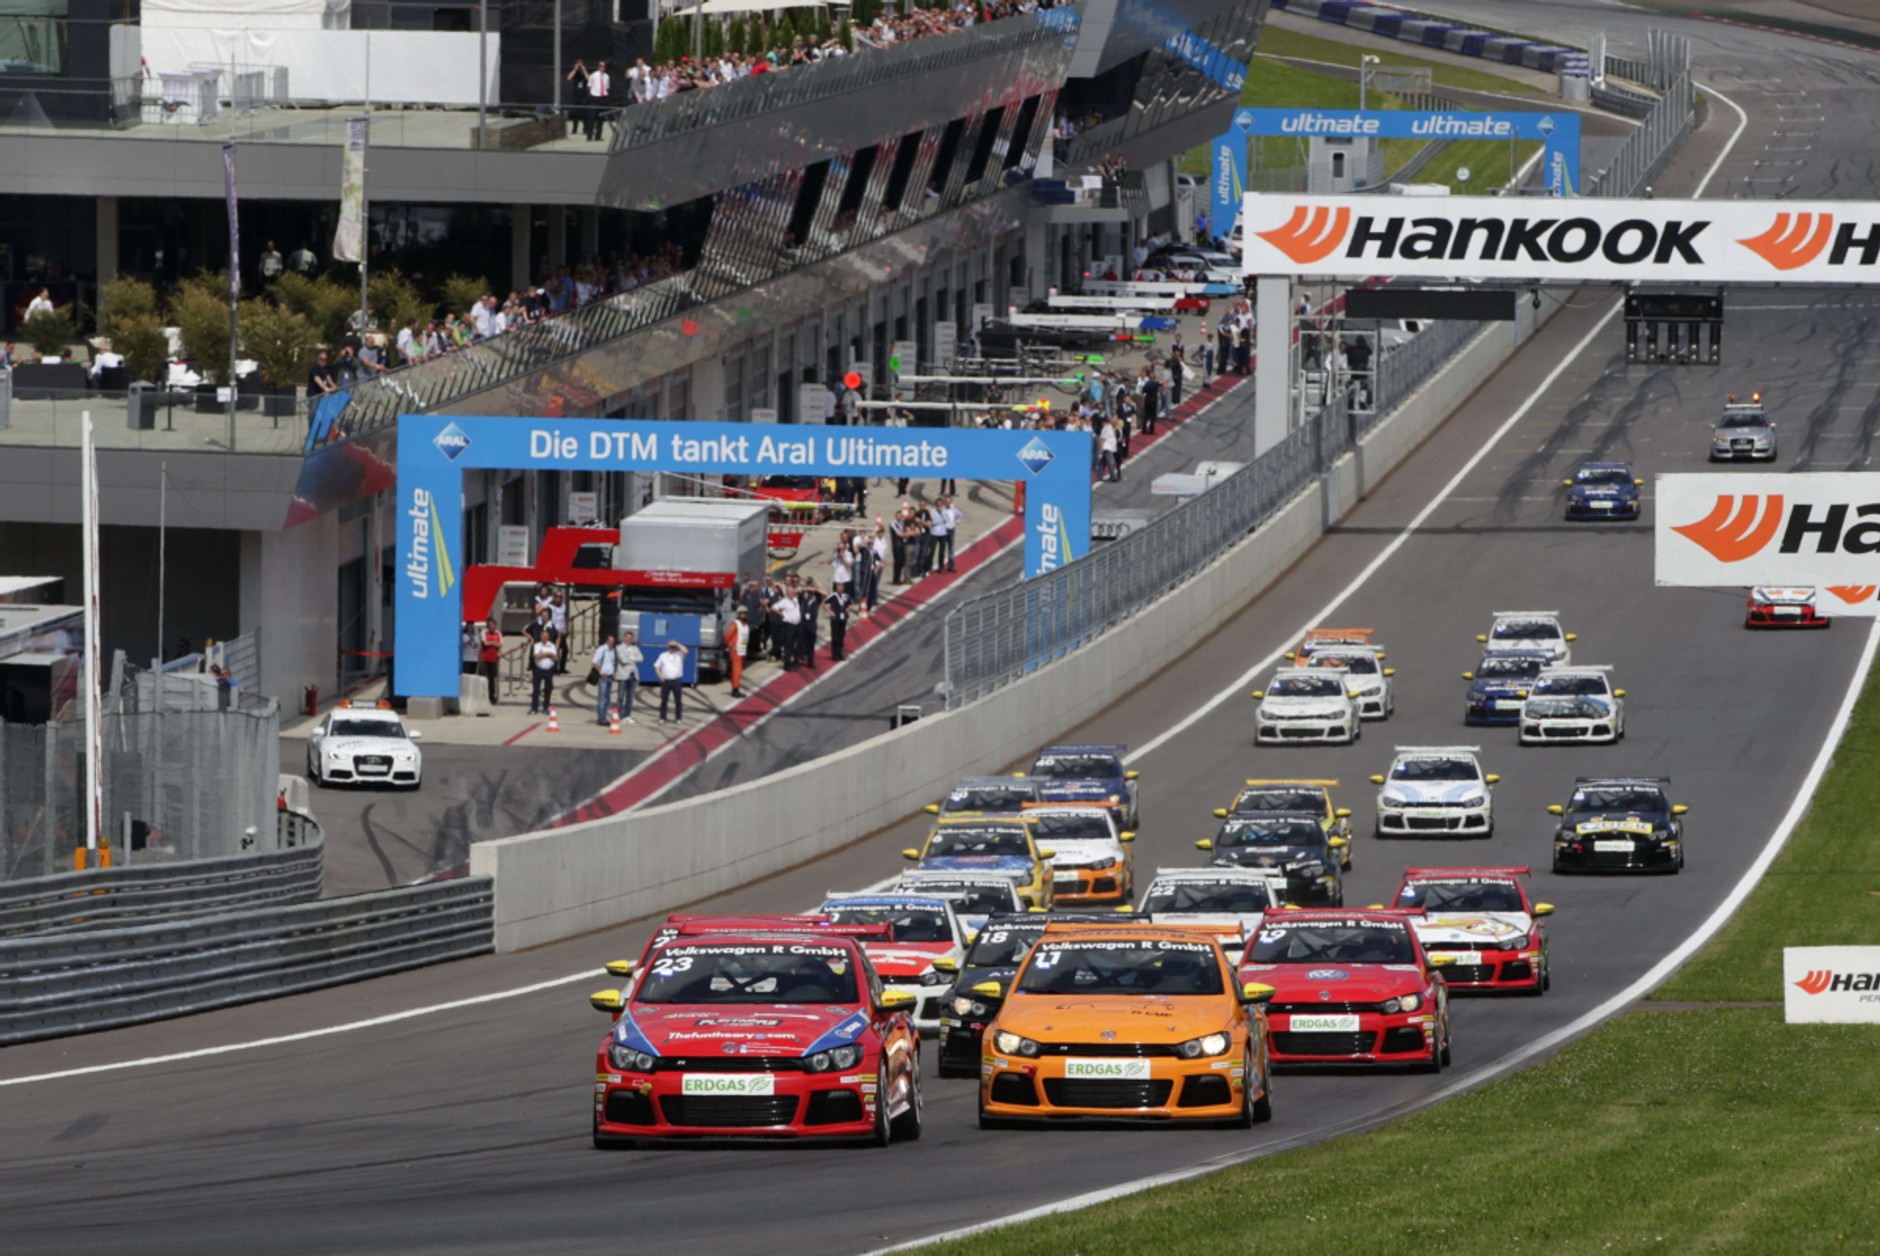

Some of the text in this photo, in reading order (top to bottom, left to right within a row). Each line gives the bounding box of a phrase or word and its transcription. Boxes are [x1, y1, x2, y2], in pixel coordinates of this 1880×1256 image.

[1281, 113, 1511, 135] ultimate ultimate
[1219, 145, 1231, 206] ultimate
[1345, 217, 1712, 265] HanKOOK
[436, 431, 469, 447] ARAL
[530, 430, 949, 467] Die DTM tankt Aral Ultimate
[1019, 446, 1051, 460] ARAL
[407, 488, 429, 599] ultimate
[1150, 886, 1176, 897] 22
[1265, 920, 1404, 930] Volkswagen R GmbH
[980, 931, 1009, 944] 18
[1258, 930, 1287, 942] 19
[665, 945, 848, 957] Volkswagen R GmbH
[1041, 941, 1211, 953] Volkswagen R GmbH
[651, 957, 694, 974] 23
[1291, 1019, 1337, 1029] ERDGAS
[1067, 1063, 1122, 1076] ERDGAS
[684, 1078, 746, 1092] ERDGAS
